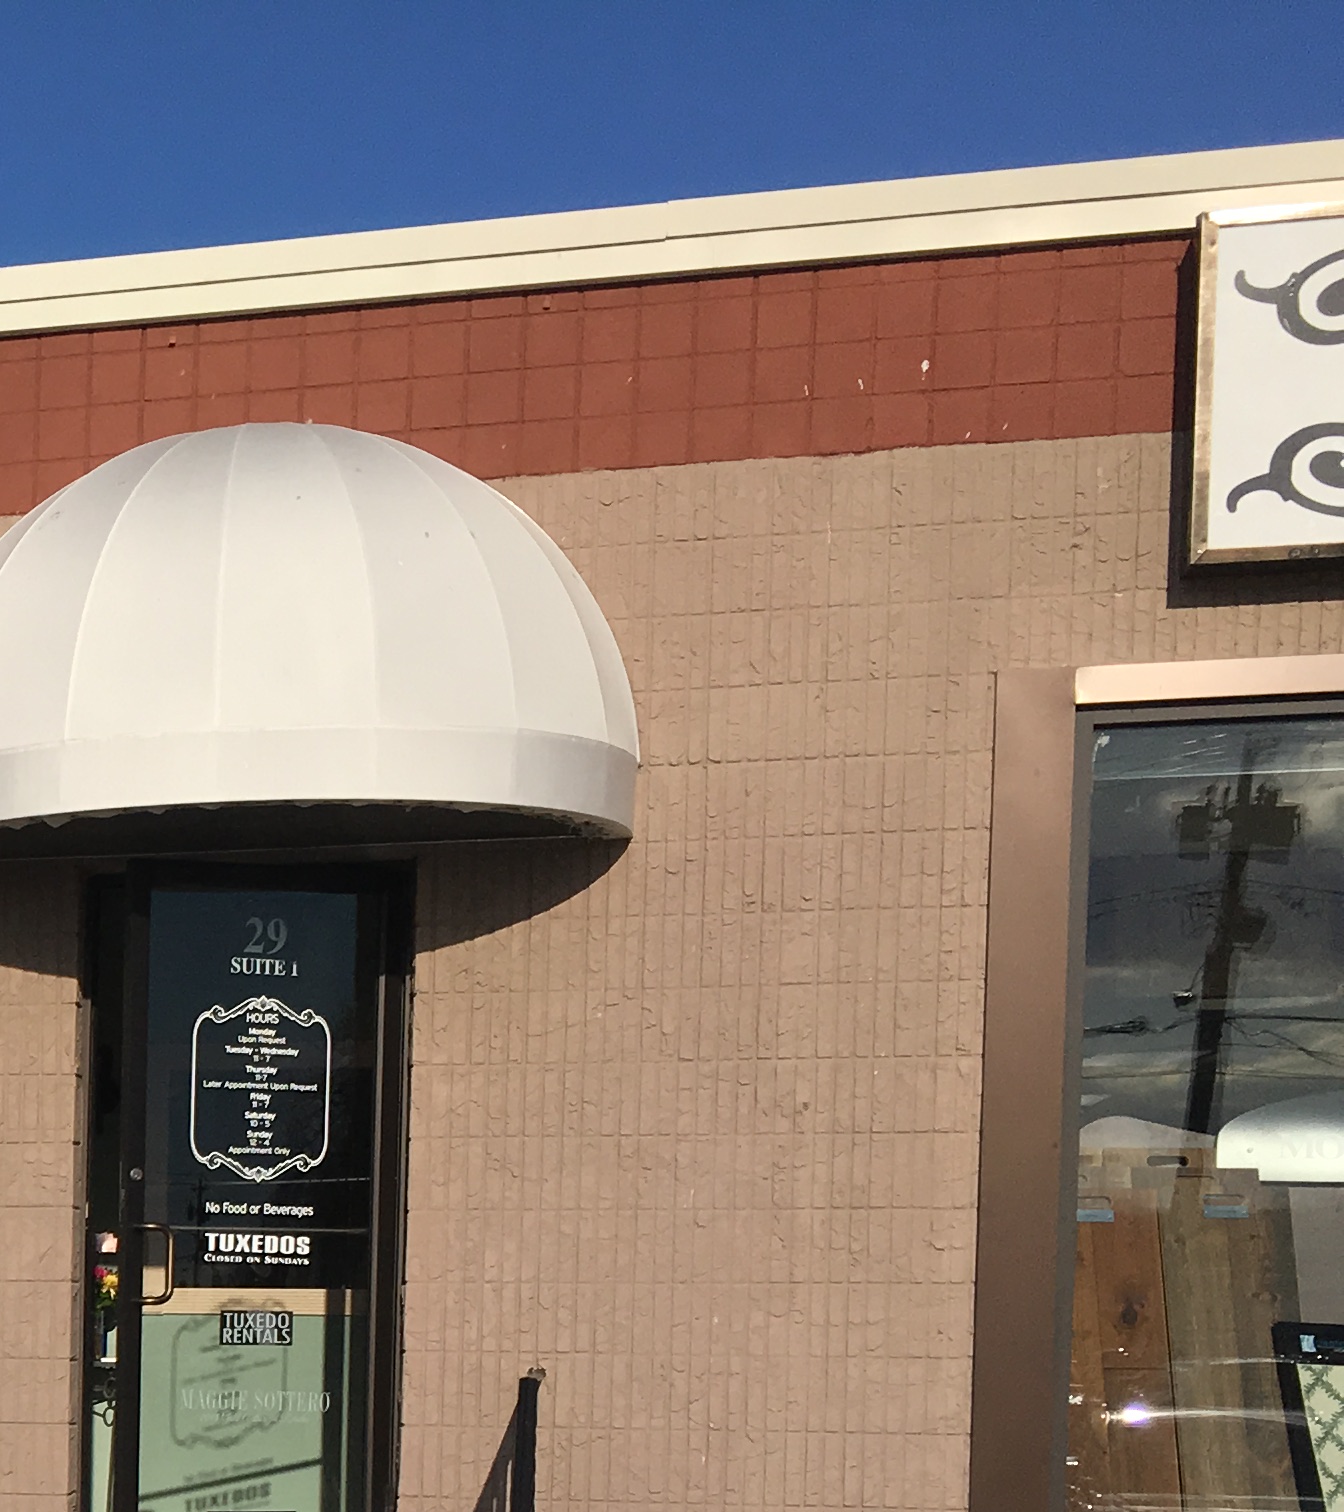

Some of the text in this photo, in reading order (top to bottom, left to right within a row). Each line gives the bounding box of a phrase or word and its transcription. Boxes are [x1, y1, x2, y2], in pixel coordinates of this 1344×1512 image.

[243, 916, 288, 955] 29
[230, 956, 298, 977] SUITE 1
[246, 1012, 280, 1024] HOURS
[248, 1027, 277, 1037] Monday
[237, 1035, 286, 1045] Upon Request
[225, 1045, 253, 1055] Tuesday
[260, 1047, 299, 1057] Wednesday
[265, 1055, 271, 1063] 7
[245, 1065, 278, 1076] Thursday
[203, 1080, 318, 1092] Later Appointment Upon Request
[250, 1092, 271, 1102] Friday
[244, 1110, 277, 1121] Saturday
[246, 1130, 273, 1140] Sunday
[228, 1146, 291, 1156] Appointment Only
[205, 1201, 314, 1218] No Food or Beverages
[205, 1232, 311, 1255] TUXEDOS
[223, 1312, 290, 1329] TUXEDO
[222, 1328, 291, 1344] RENTALS
[181, 1389, 331, 1413] MAGGIE SOTTERO
